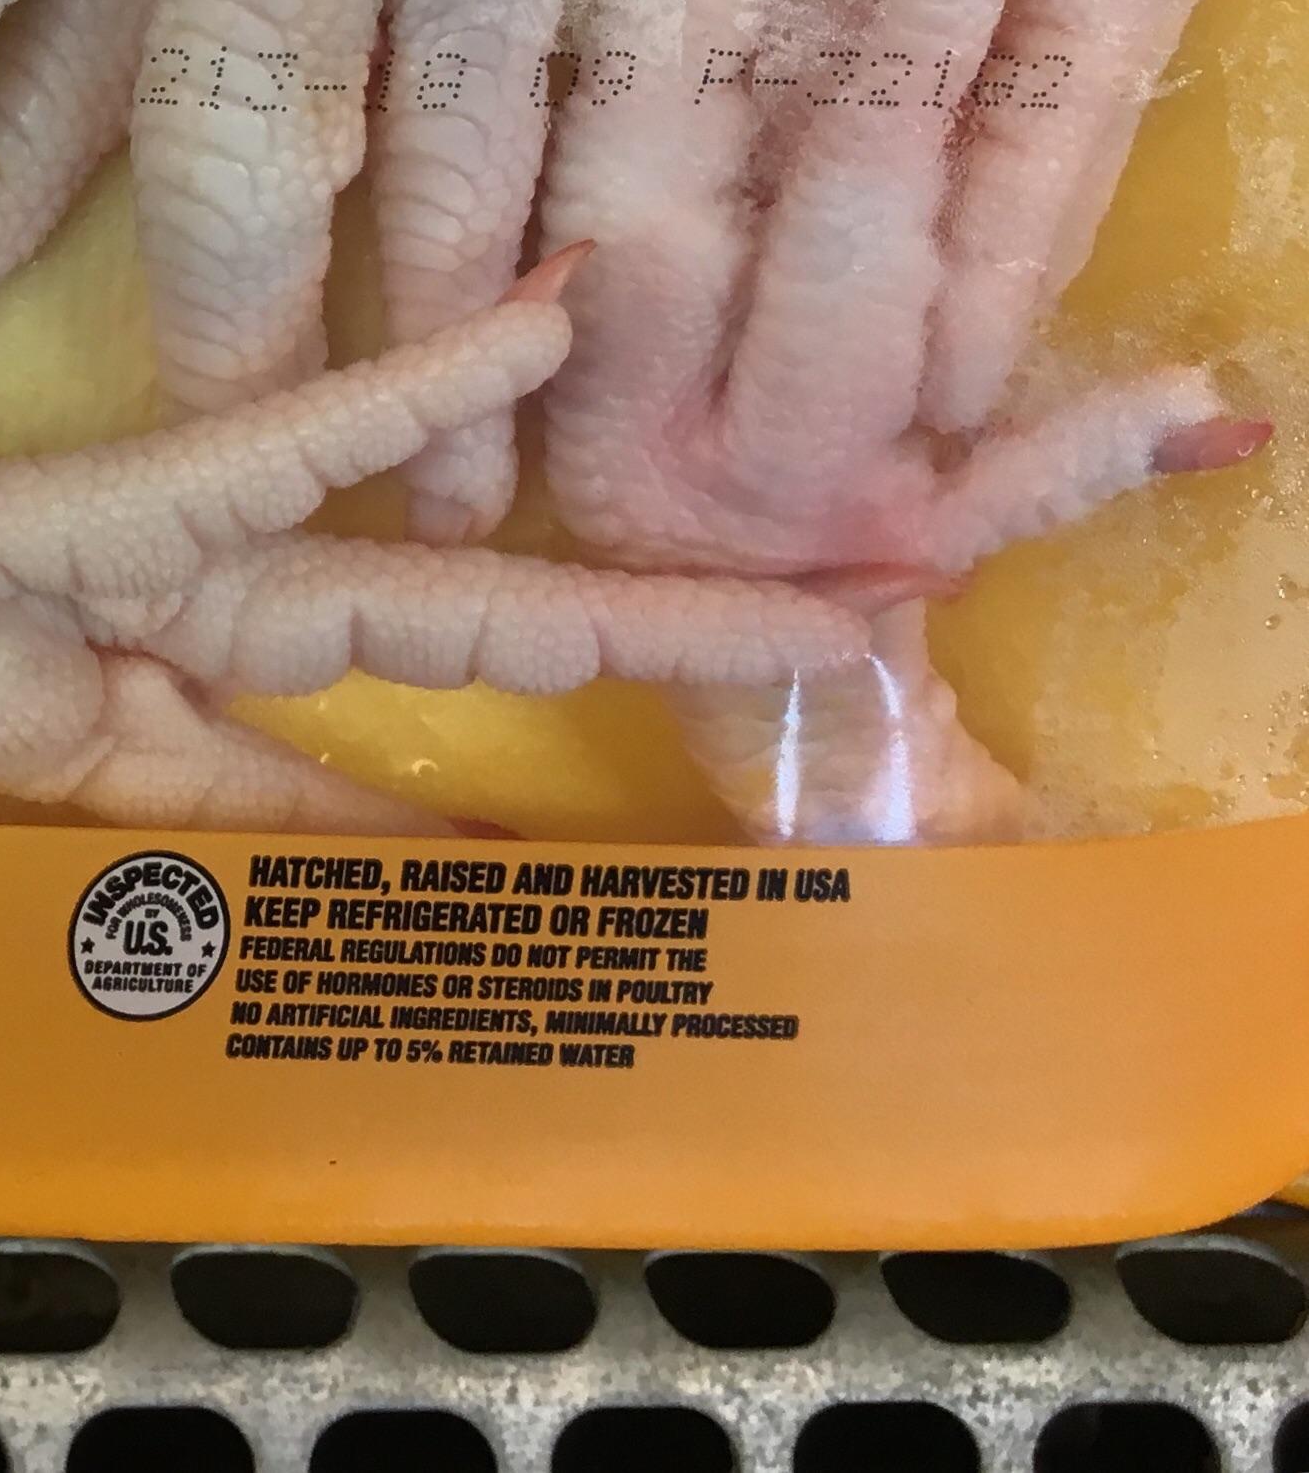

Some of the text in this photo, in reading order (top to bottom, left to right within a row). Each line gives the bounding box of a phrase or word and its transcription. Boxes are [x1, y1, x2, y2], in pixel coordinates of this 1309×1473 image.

[82, 861, 219, 930] INSPECTED
[248, 855, 851, 903] HATCHED, RAISED AND HARVESTED IN USA
[105, 917, 122, 940] FOR
[244, 896, 709, 940] KEEP REFRIGERATED OR FROZEN
[123, 920, 173, 956] U.S.
[239, 935, 708, 972] FEDERAL REGULATIONS DO NOT PERMIT THE
[84, 960, 207, 977] DEPARTMENT OF
[92, 977, 194, 993] AGRICULTURE
[235, 968, 714, 1006] USE OF HORMONES OR STEROIDS IN POULTRY
[230, 1001, 799, 1041] NO ARTIFICIAL INGREDIENTS, MINIMALLY PROCESSED
[226, 1033, 636, 1069] CONTAINS UP TO 5% RETAINED WATER
